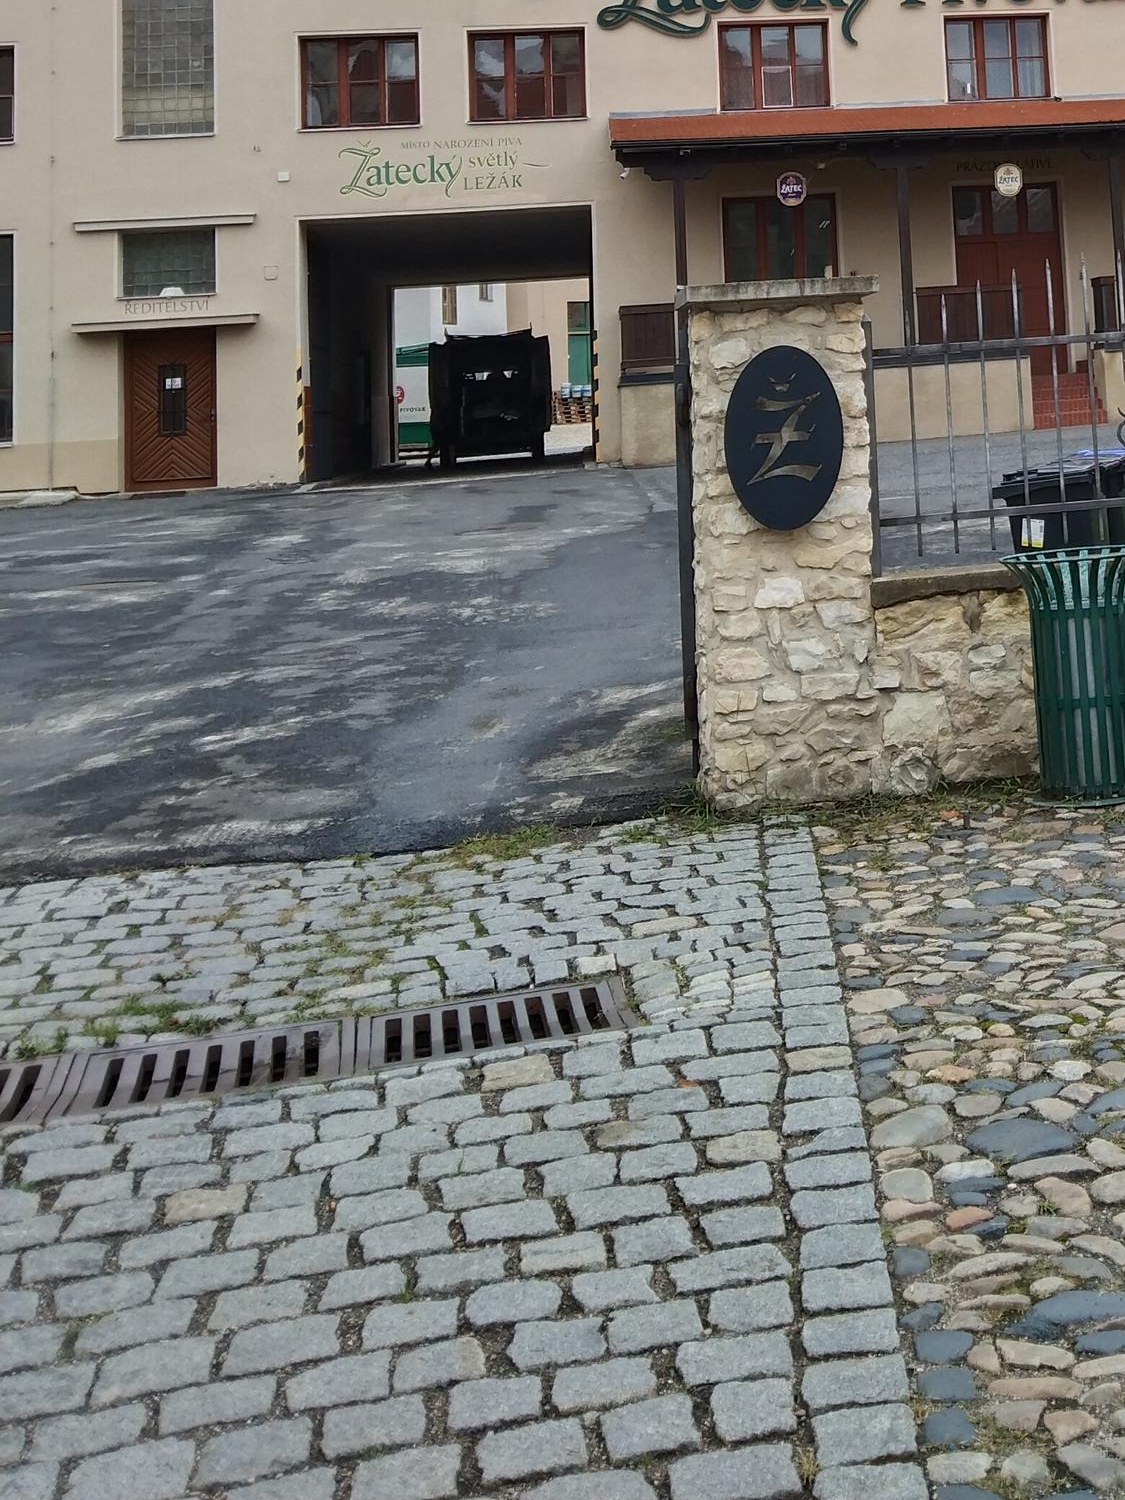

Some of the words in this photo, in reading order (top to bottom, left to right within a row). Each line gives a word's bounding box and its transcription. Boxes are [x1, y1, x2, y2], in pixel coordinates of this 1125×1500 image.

[498, 136, 523, 147] PIVA
[338, 140, 463, 198] Žatecký
[468, 150, 519, 170] světlý
[463, 172, 523, 191] LEŽÁK
